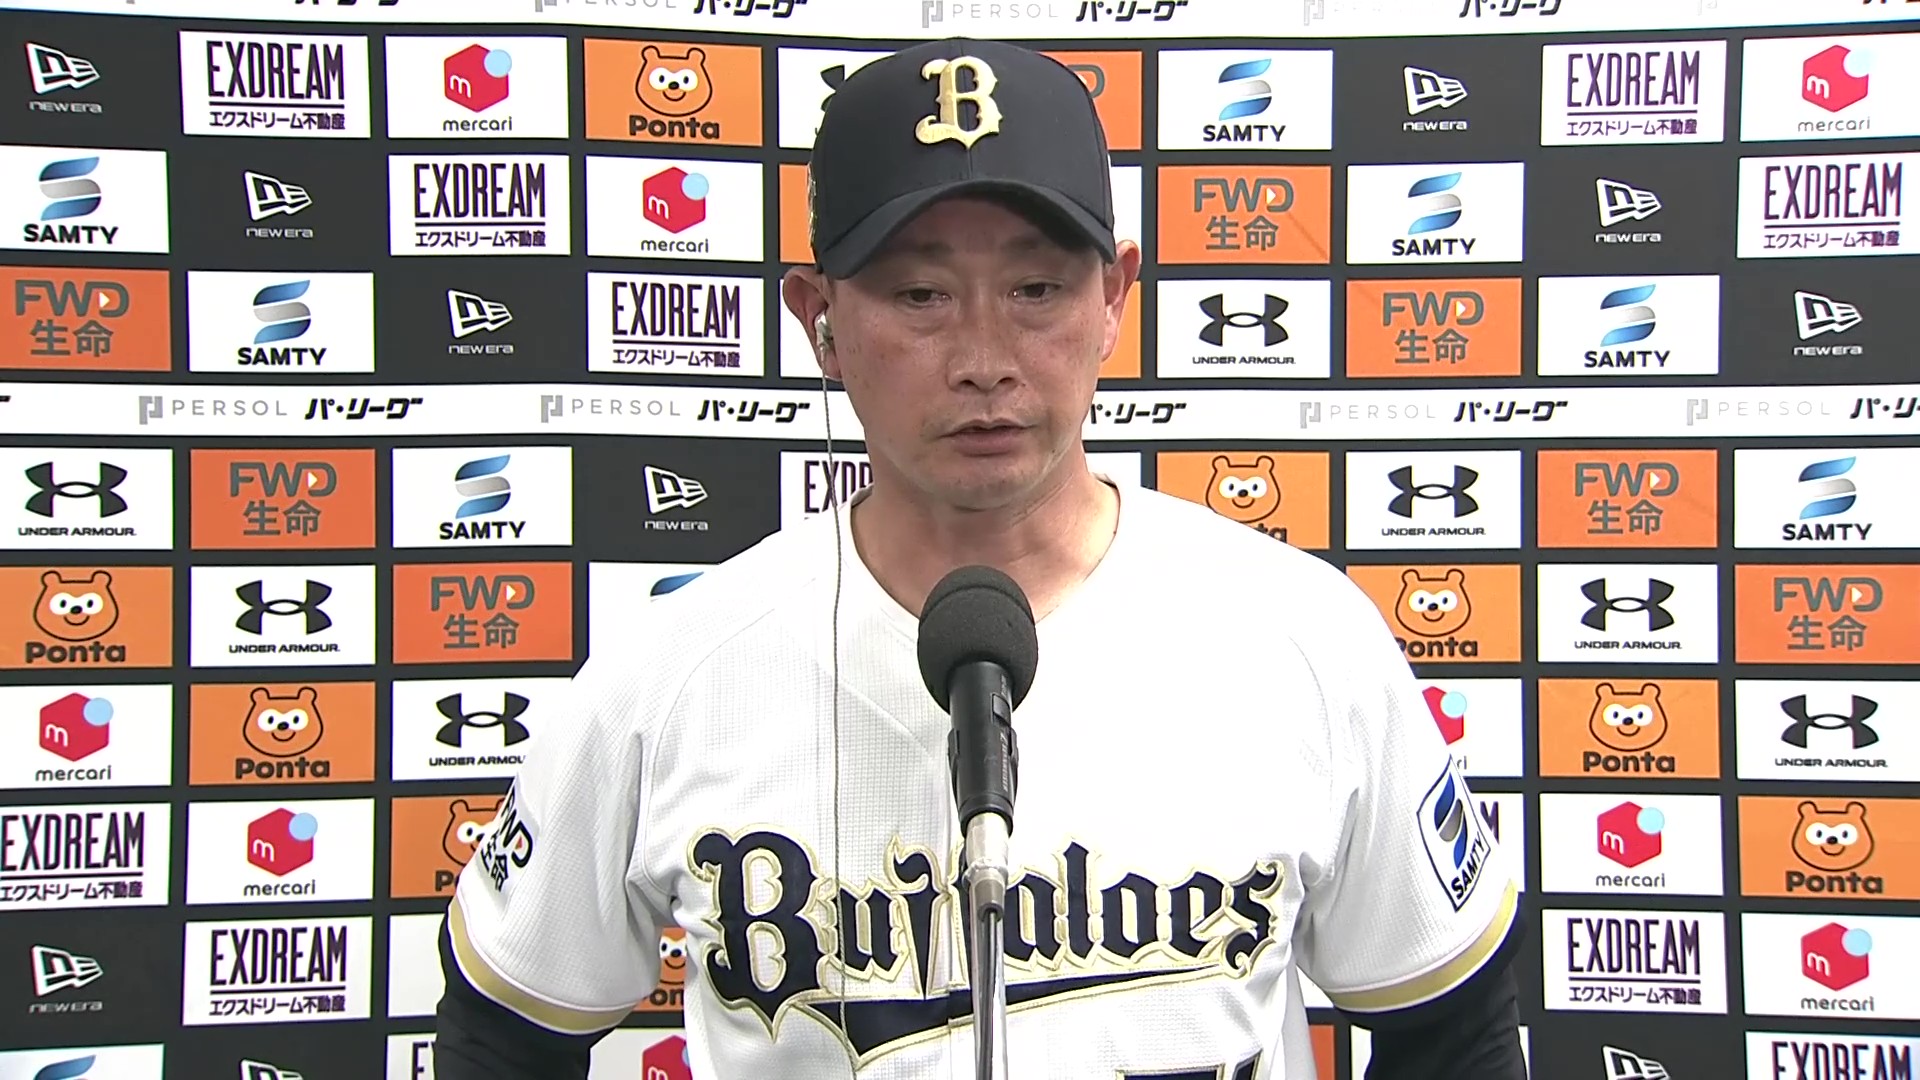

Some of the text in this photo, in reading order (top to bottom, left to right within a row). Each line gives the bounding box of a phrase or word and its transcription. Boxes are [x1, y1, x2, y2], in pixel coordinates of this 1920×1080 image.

[953, 4, 1058, 18] PERSOL
[207, 40, 344, 102] EXDREAM
[1567, 51, 1700, 107] EXDREAM
[915, 55, 1003, 150] B
[209, 108, 345, 130] エクスドリーム不動産
[443, 116, 512, 131] mercari
[627, 115, 719, 141] Ponta
[1566, 118, 1697, 136] エクスドリーム不動産
[1798, 117, 1870, 131] mercari
[1203, 125, 1285, 141] SAMTY
[414, 163, 545, 218] EXDREAM
[1194, 178, 1294, 213] FWD
[1764, 162, 1902, 220] EXDREAM
[24, 224, 118, 244] SAMTY
[415, 230, 546, 247] エクスドリーム不動産
[1206, 215, 1278, 251] 生命
[1764, 228, 1900, 249] エクスドリーム不動産
[641, 239, 708, 253] mercari
[1393, 238, 1475, 256] SAMTY
[15, 280, 129, 317] FWD
[1383, 291, 1484, 326] FWD
[612, 282, 740, 341] EXDREAM
[30, 319, 113, 357] 生命
[1395, 329, 1469, 364] 生命
[238, 347, 326, 365] SAMTY
[613, 347, 740, 368] エクスドリーム不動産
[1193, 356, 1237, 364] UNDER
[1585, 351, 1670, 368] SAMTY
[172, 400, 287, 416] PERSOL
[572, 399, 680, 416] PERSOL
[1331, 405, 1435, 419] PERSOL
[1719, 401, 1830, 416] PERSOL
[230, 462, 337, 497] FWD
[1575, 463, 1680, 497] FWD
[243, 500, 321, 536] 生命
[1588, 500, 1663, 535] 生命
[18, 527, 69, 536] UNDER
[440, 521, 525, 540] SAMTY
[1382, 528, 1426, 536] UNDER
[1783, 524, 1872, 540] SAMTY
[431, 575, 535, 611] FWD
[1774, 577, 1883, 612] FWD
[444, 614, 519, 649] 生命
[1787, 615, 1867, 651] 生命
[26, 640, 125, 663] Ponta
[229, 644, 277, 653] UNDER
[1575, 641, 1620, 649] UNDER
[236, 756, 330, 779] Ponta
[429, 755, 526, 766] UNDER ARMOU
[1583, 749, 1675, 773] Ponta
[1775, 758, 1823, 767] UNDER
[35, 765, 111, 781] mercari
[0, 812, 144, 874] EXDREAM
[1451, 832, 1484, 900] SAMTY
[0, 878, 142, 902] エクスドリーム不動産
[244, 876, 315, 896] mercari
[1596, 873, 1665, 887] mercari
[1786, 869, 1883, 894] Ponta
[210, 926, 347, 988] EXDREAM
[1568, 918, 1700, 975] EXDREAM
[209, 992, 345, 1016] エクスドリーム不動産
[1569, 983, 1701, 1005] エクスドリーム不動産
[1801, 996, 1874, 1011] mercari
[1771, 1041, 1912, 1080] EXDREAM
